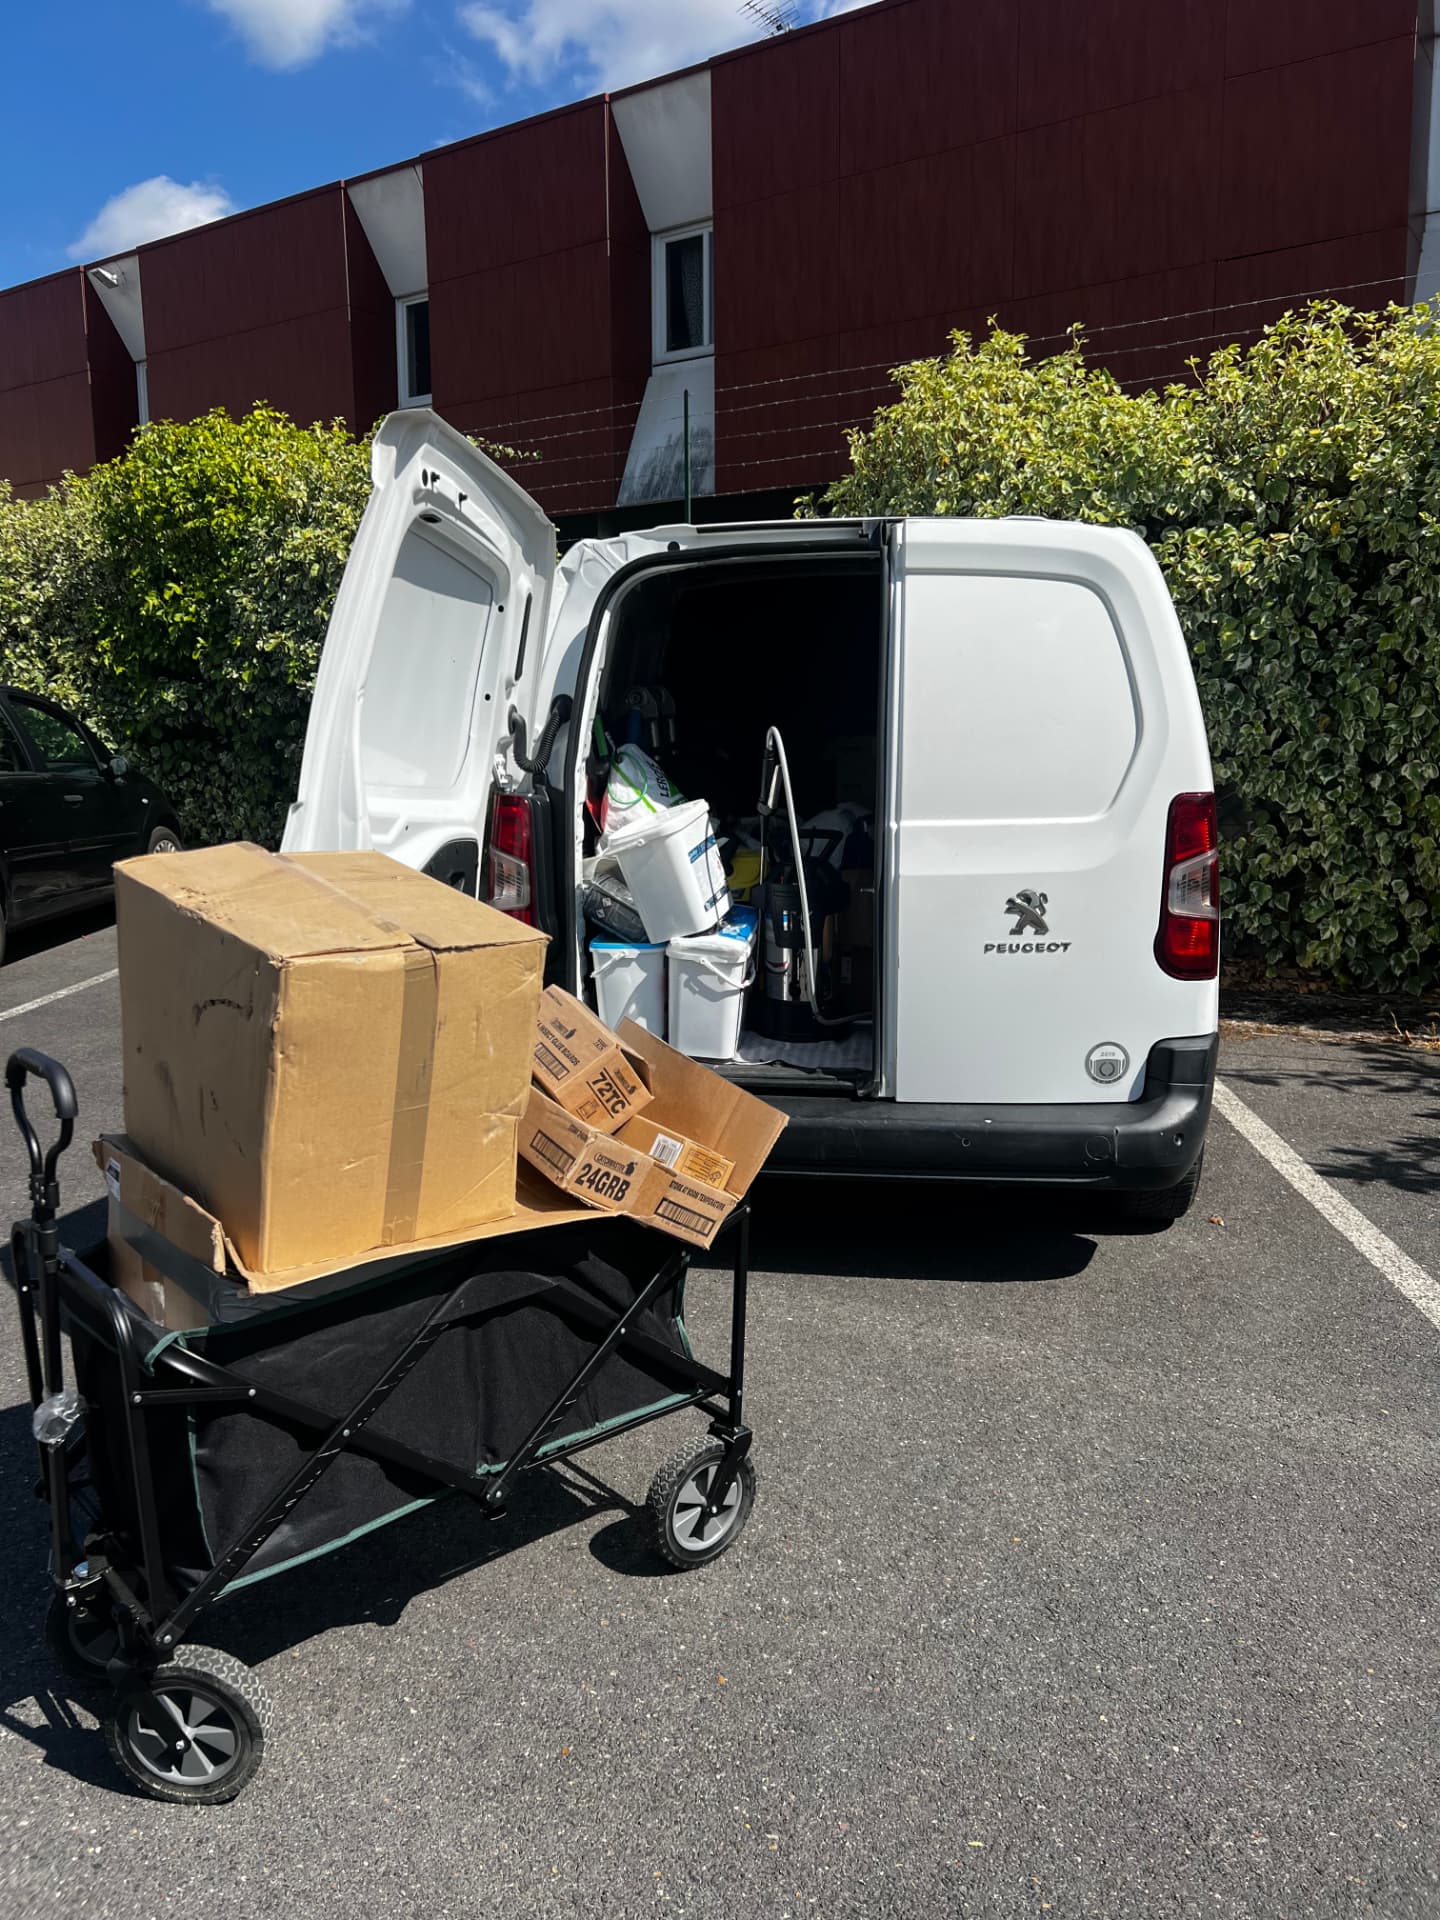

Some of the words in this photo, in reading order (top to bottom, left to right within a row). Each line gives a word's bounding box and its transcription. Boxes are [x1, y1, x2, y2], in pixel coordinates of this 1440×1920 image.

[984, 942, 1072, 954] PEUGEOT
[592, 1071, 627, 1114] 72TC
[575, 1163, 631, 1202] 24GRB
